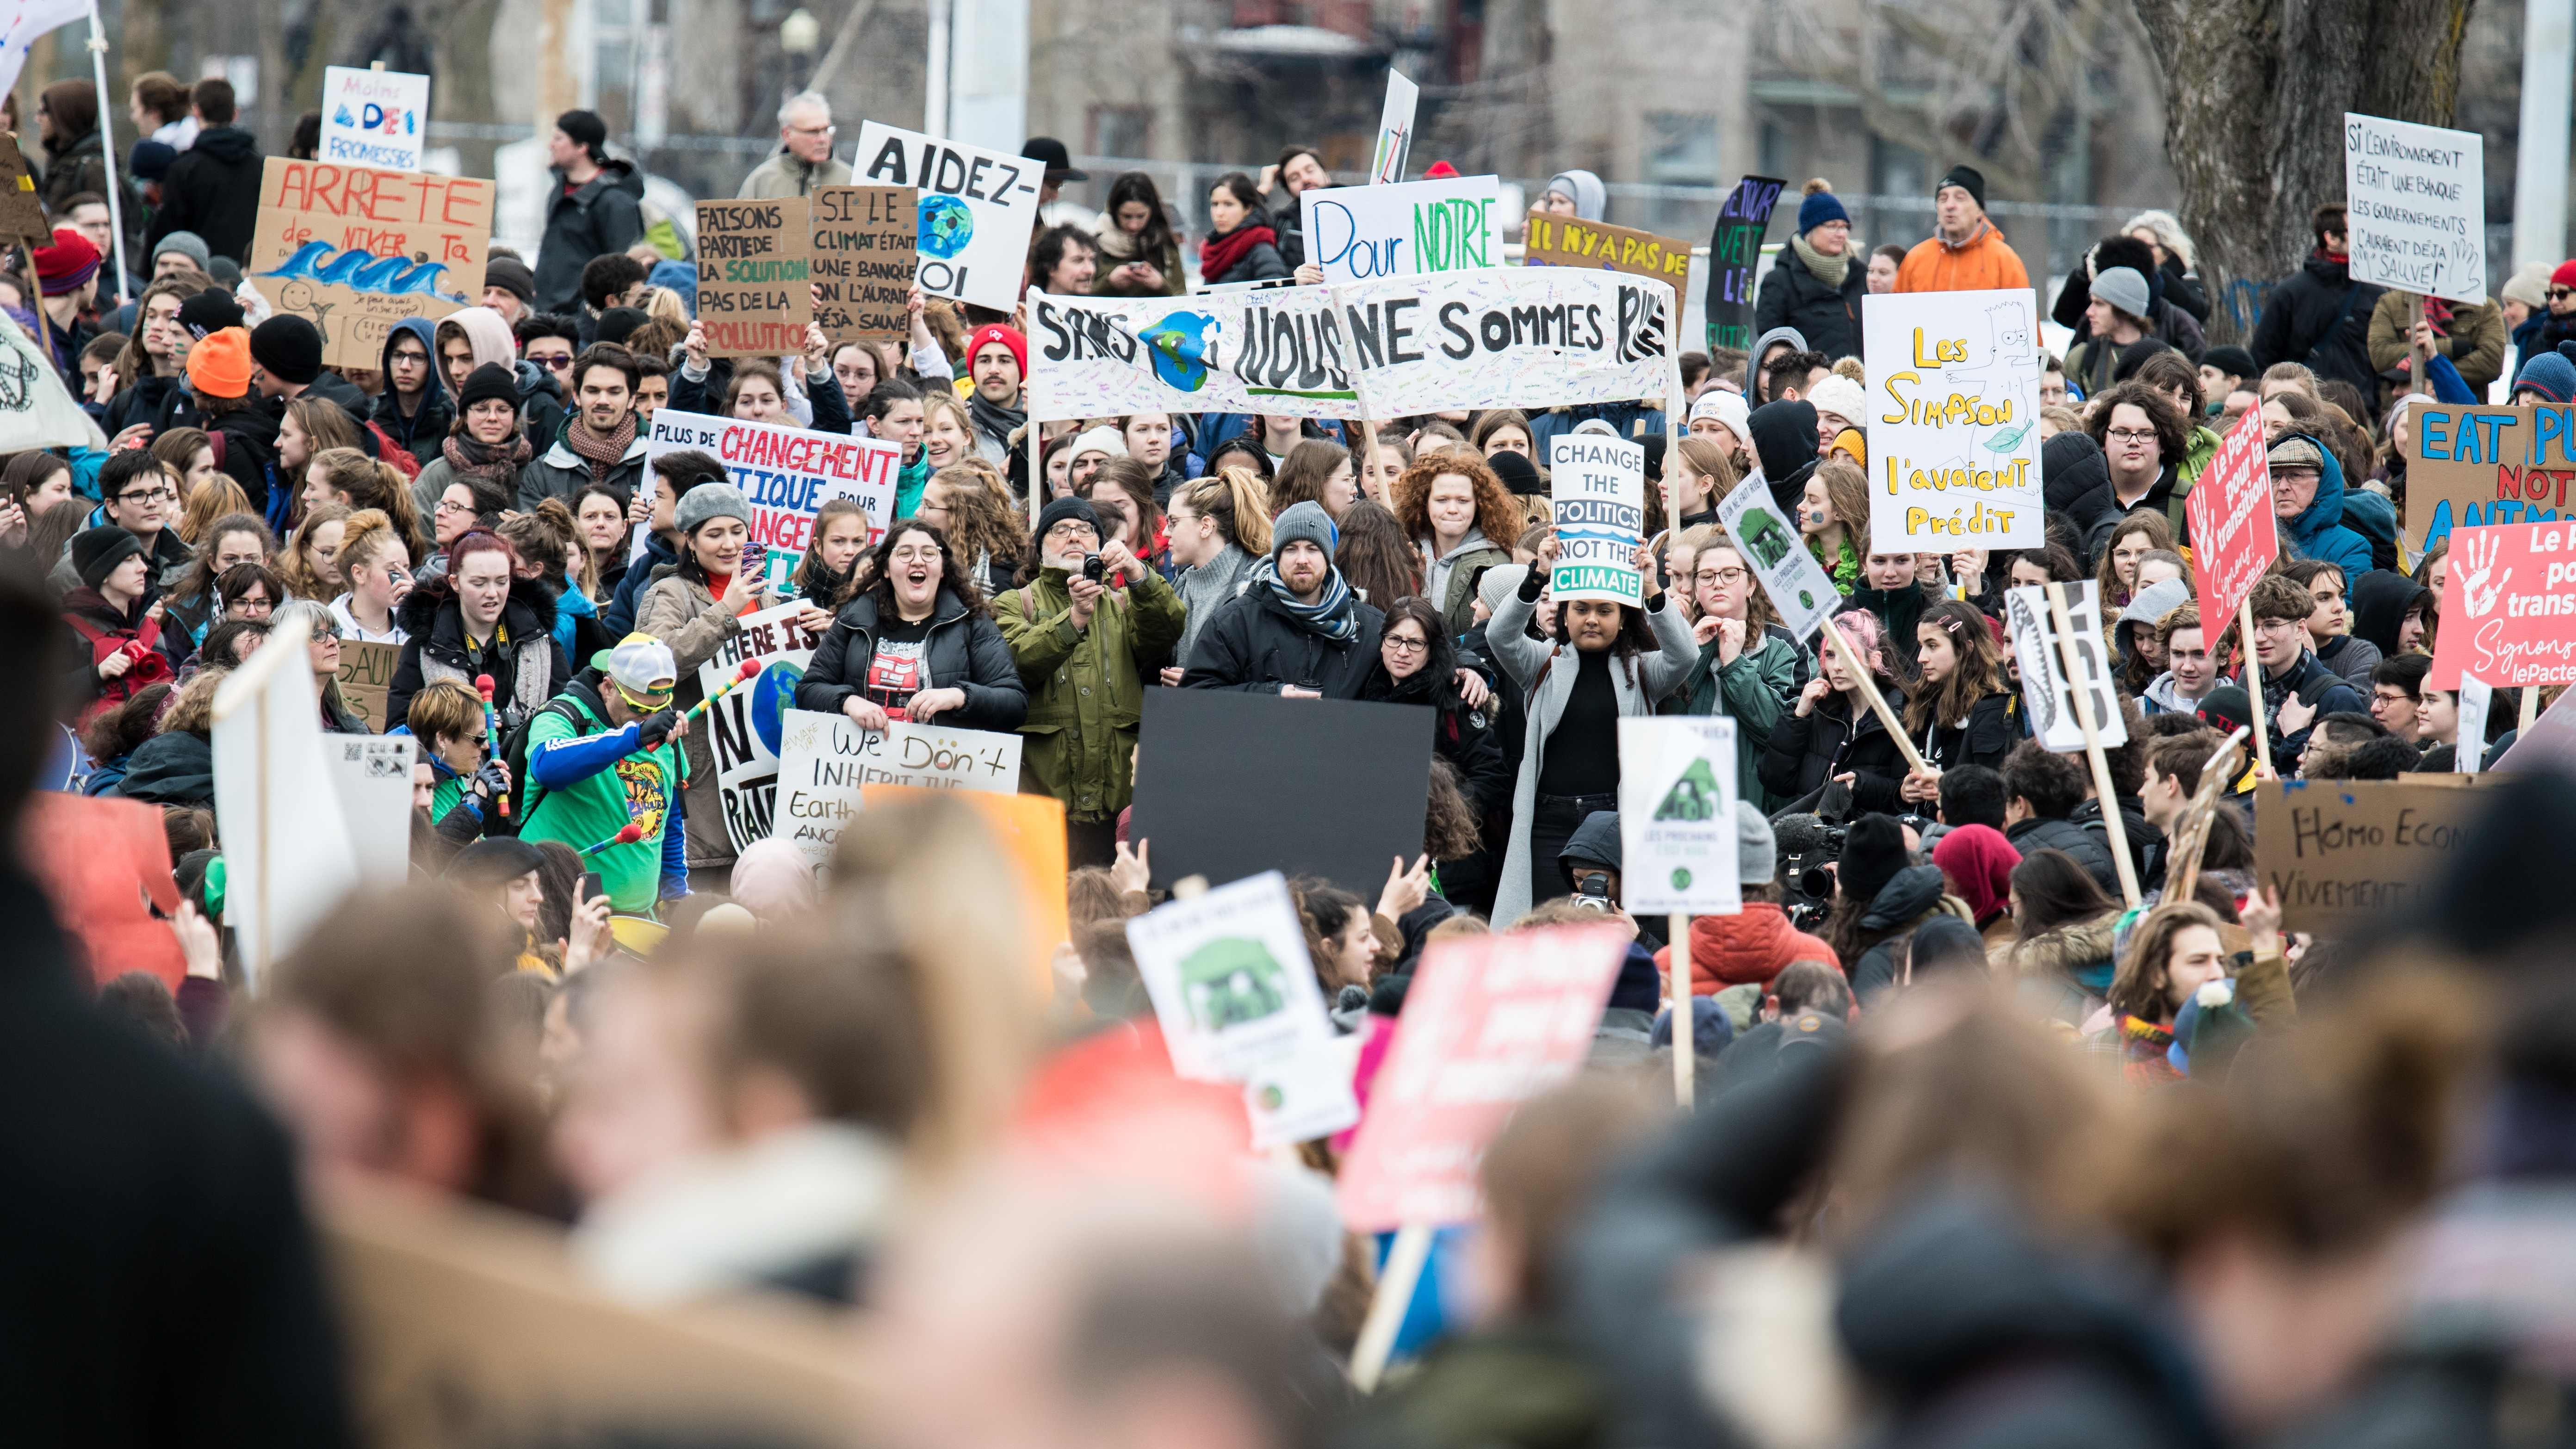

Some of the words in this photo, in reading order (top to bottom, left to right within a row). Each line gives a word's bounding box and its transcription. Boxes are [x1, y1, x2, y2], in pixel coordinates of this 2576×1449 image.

[329, 136, 415, 168] PROMESSES
[867, 137, 1035, 206] AIDEZ-
[2392, 173, 2414, 197] UNE
[2417, 175, 2462, 201] BANQUE
[696, 207, 782, 232] FAISONS
[822, 191, 852, 222] SI
[869, 193, 897, 223] LE
[2352, 192, 2370, 216] LES
[2373, 202, 2466, 235] GOUVERNEMENTS
[282, 217, 312, 243] de
[814, 230, 876, 250] CLIMAT
[880, 229, 917, 251] ÉTAIT
[1313, 201, 1402, 278] Pour
[1414, 198, 1495, 274] NOTRE
[1529, 217, 1552, 250] IL
[1561, 223, 1598, 256] N'Y
[1597, 234, 1617, 260] A
[1621, 236, 1660, 270] PAS
[1663, 251, 1688, 276] DE
[699, 263, 720, 282] LA
[726, 256, 809, 281] SOLUTION
[814, 259, 850, 279] UNE
[857, 261, 917, 279] BANQUE
[916, 257, 968, 297] OI
[1583, 274, 1600, 291] Lucas
[699, 291, 734, 311] PAS
[740, 291, 762, 310] DE
[767, 290, 791, 310] LA
[849, 283, 906, 304] L'AURAIT
[1037, 301, 1137, 363] SANS
[1234, 306, 1350, 391] NOUS
[1346, 297, 1424, 371] NE
[1439, 301, 1604, 360] SOMMES
[1913, 327, 1967, 369] Les
[2213, 457, 2228, 484] Le
[2227, 411, 2260, 457] Pacte
[2422, 411, 2517, 464] EAT
[655, 424, 692, 444] PLUS
[699, 432, 716, 447] DE
[721, 425, 899, 485] CHANGEMENT
[1555, 445, 1640, 473] CHANGE
[1583, 474, 1618, 494] THE
[2225, 462, 2251, 511] pour
[2250, 440, 2264, 470] la
[2498, 464, 2575, 507] NOT
[1739, 488, 1752, 505] FAIT
[1557, 502, 1639, 529] POLITICS
[2216, 474, 2267, 551] transition
[1560, 540, 1601, 559] NOT
[1608, 542, 1635, 565] THE
[2530, 527, 2560, 553] Le
[1556, 568, 1637, 595] CLIMATE
[2007, 695, 2016, 713] Nikon
[833, 722, 881, 757] We
[790, 791, 857, 820] Earth
